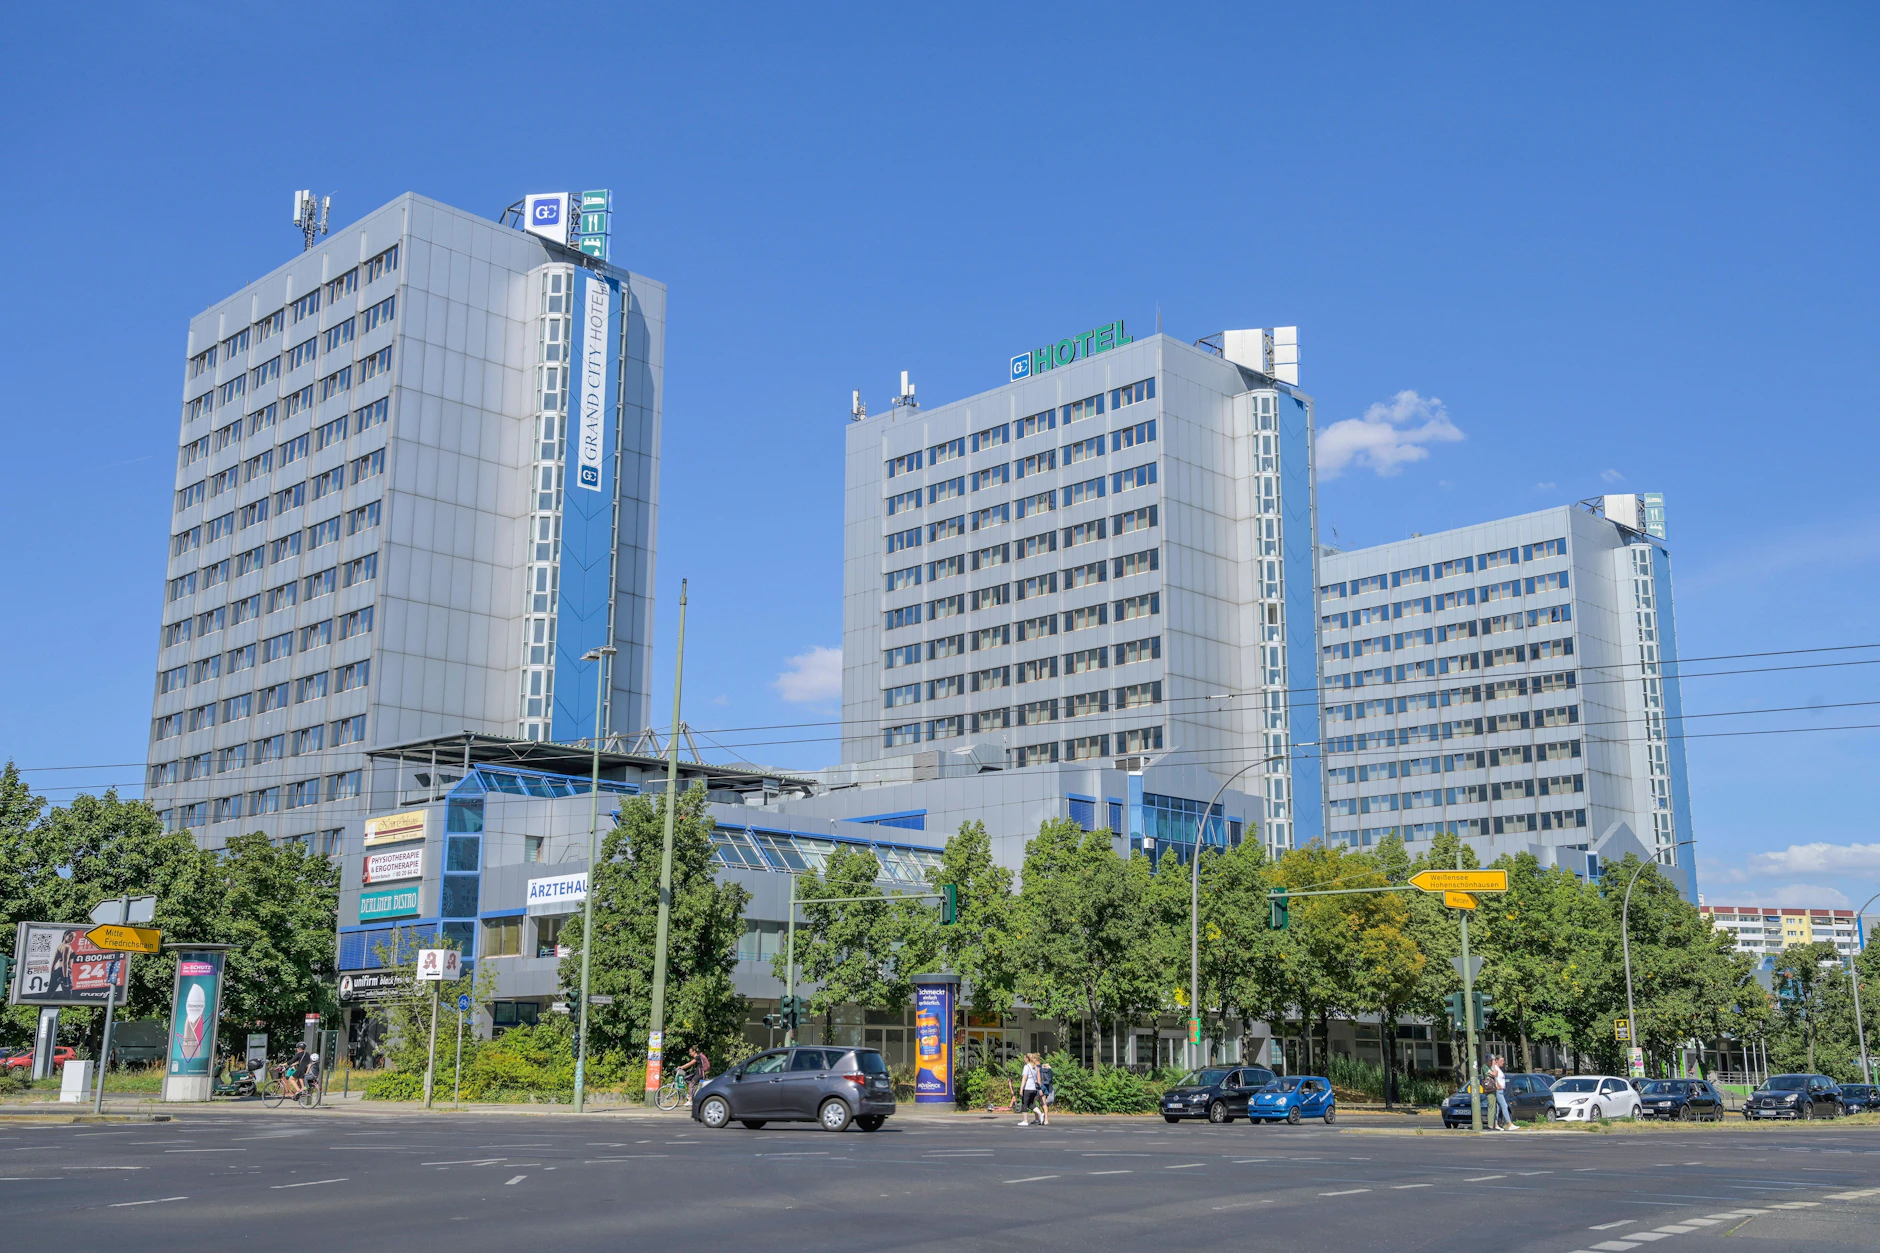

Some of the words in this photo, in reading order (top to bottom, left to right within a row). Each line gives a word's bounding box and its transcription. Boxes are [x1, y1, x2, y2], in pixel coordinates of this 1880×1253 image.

[535, 204, 557, 220] GC
[590, 289, 604, 341] HOTEL
[1032, 319, 1133, 375] HOTEL
[587, 344, 602, 389] CITY
[584, 393, 600, 461] GRAND
[371, 850, 420, 865] PHYSIOTHERAPIE
[375, 860, 419, 873] ERGOTHERAPIE
[530, 880, 588, 898] ÄRZTEHAU
[361, 895, 393, 914] BERLINER
[393, 892, 417, 910] BISTRO
[1452, 896, 1469, 904] Marzahn
[105, 929, 123, 937] Mitte
[104, 938, 154, 949] Friedrichshain
[86, 954, 103, 962] 800
[354, 975, 379, 988] unifirm
